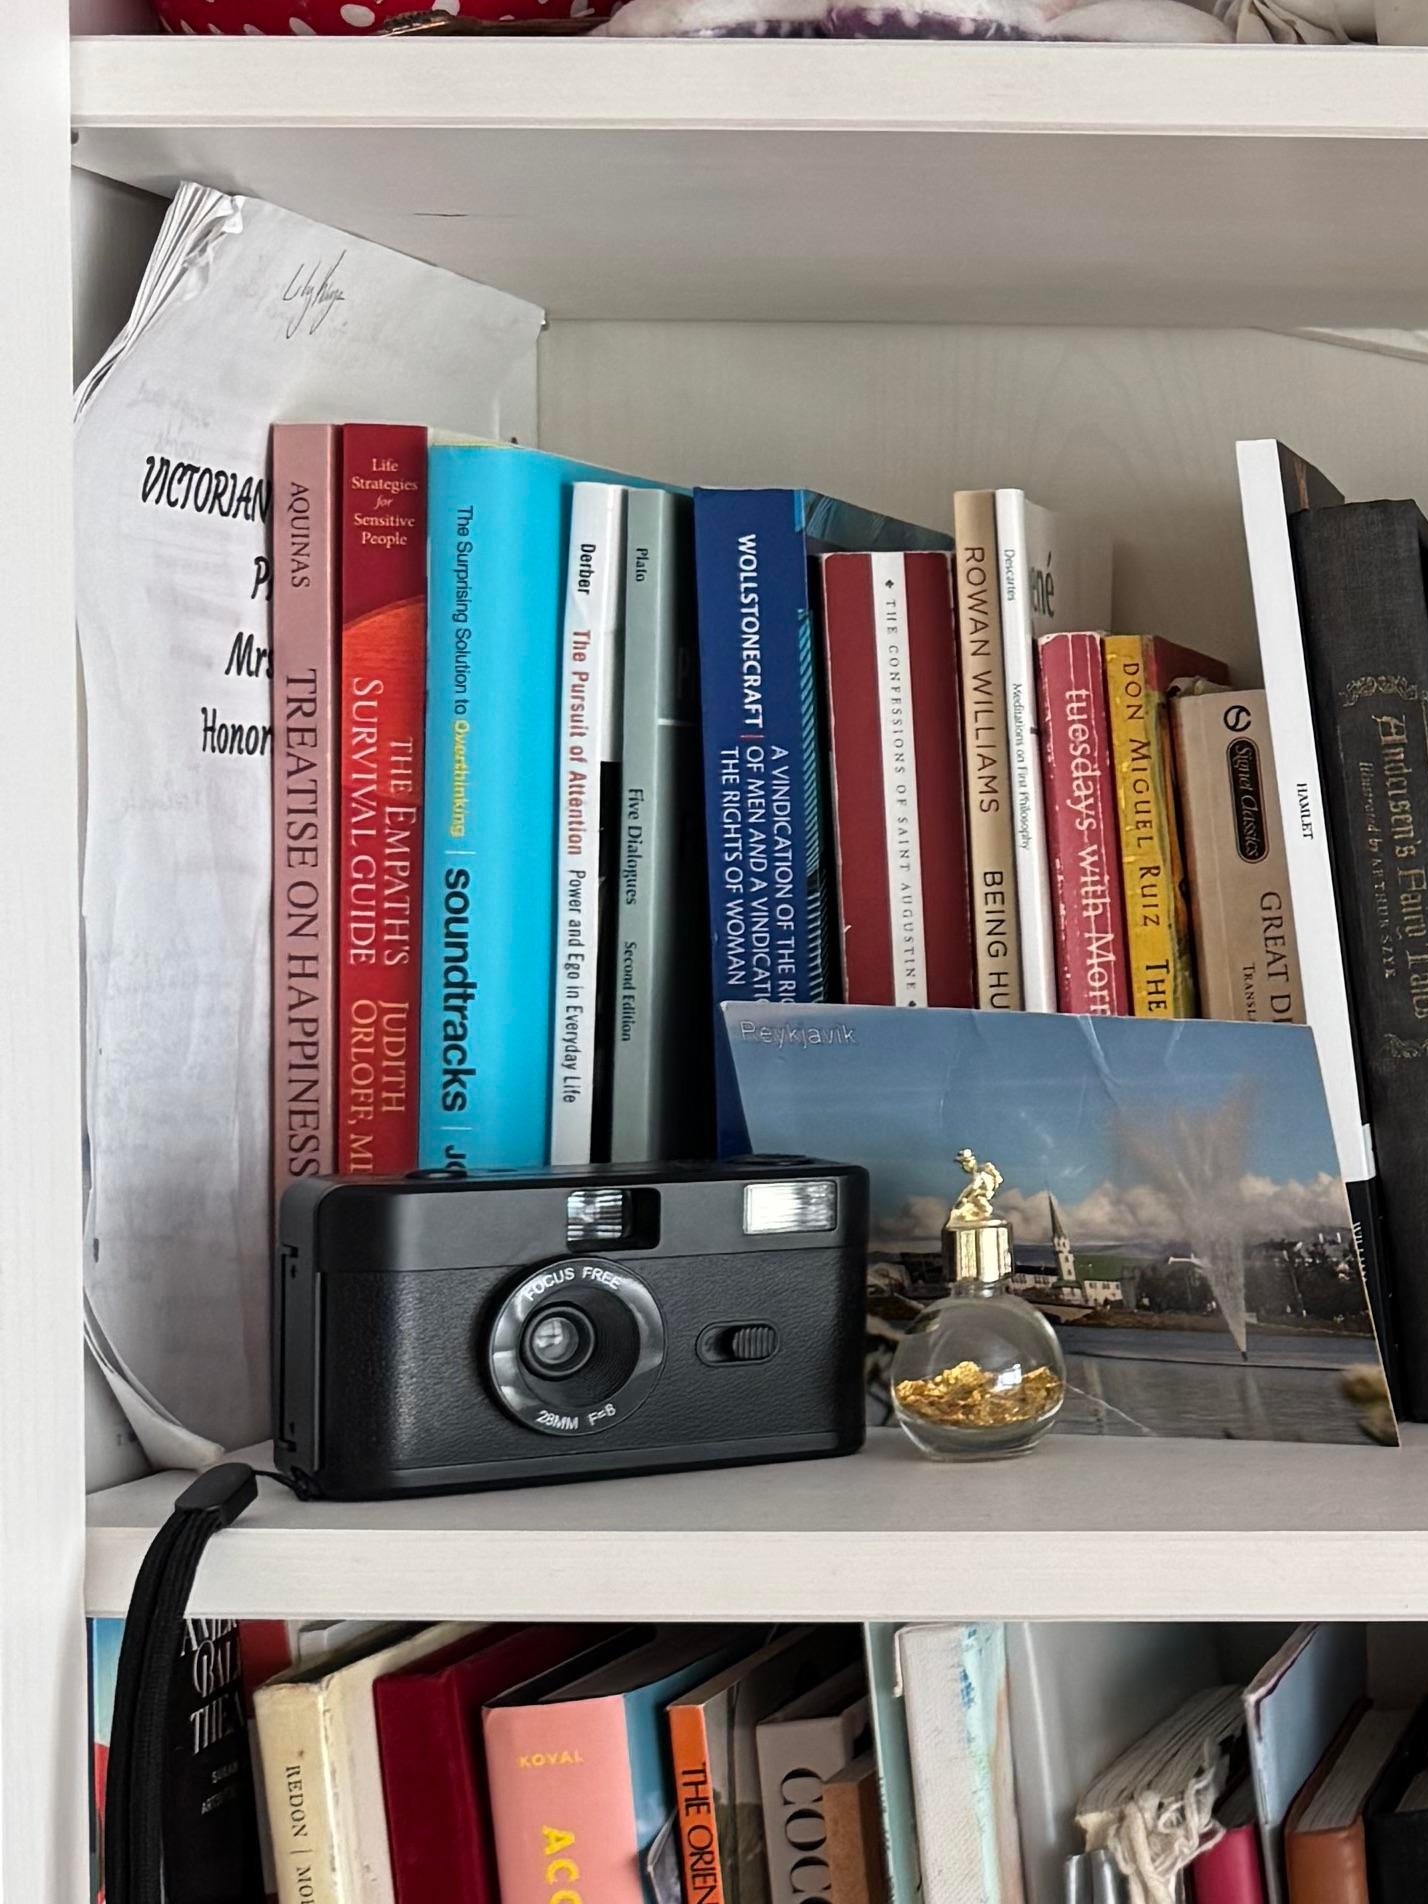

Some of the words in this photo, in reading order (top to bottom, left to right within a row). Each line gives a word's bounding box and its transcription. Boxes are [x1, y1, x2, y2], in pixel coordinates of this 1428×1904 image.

[141, 456, 274, 521] VICTORIAN
[351, 476, 418, 492] Strategies
[372, 458, 398, 473] Life
[353, 514, 415, 527] Sensitive
[375, 496, 393, 508] for
[291, 482, 309, 588] AQUINAS
[361, 532, 407, 546] People
[636, 547, 648, 582] Plato
[737, 533, 763, 728] WOLLSTONECRAFT
[286, 669, 318, 869] TREATISE
[351, 677, 384, 846] SURVIVAL
[389, 737, 412, 793] THE
[720, 746, 739, 784] THE
[628, 788, 643, 820] Five
[722, 791, 743, 862] RIGHTS
[1296, 783, 1313, 840] HAMLET
[384, 805, 417, 966] EMPATH'S
[622, 826, 641, 906] Dialogues
[725, 867, 743, 893] OF
[287, 880, 318, 939] ON
[350, 855, 377, 964] GUIDE
[726, 899, 745, 985] WOMAN
[442, 868, 476, 1113] soundtracks
[288, 955, 320, 1176] HAPPINESS
[522, 1267, 576, 1301] FOCUS
[582, 1266, 623, 1290] FREE
[536, 1409, 579, 1431] 28MM
[285, 1765, 307, 1838] REDON
[679, 1763, 711, 1813] THE
